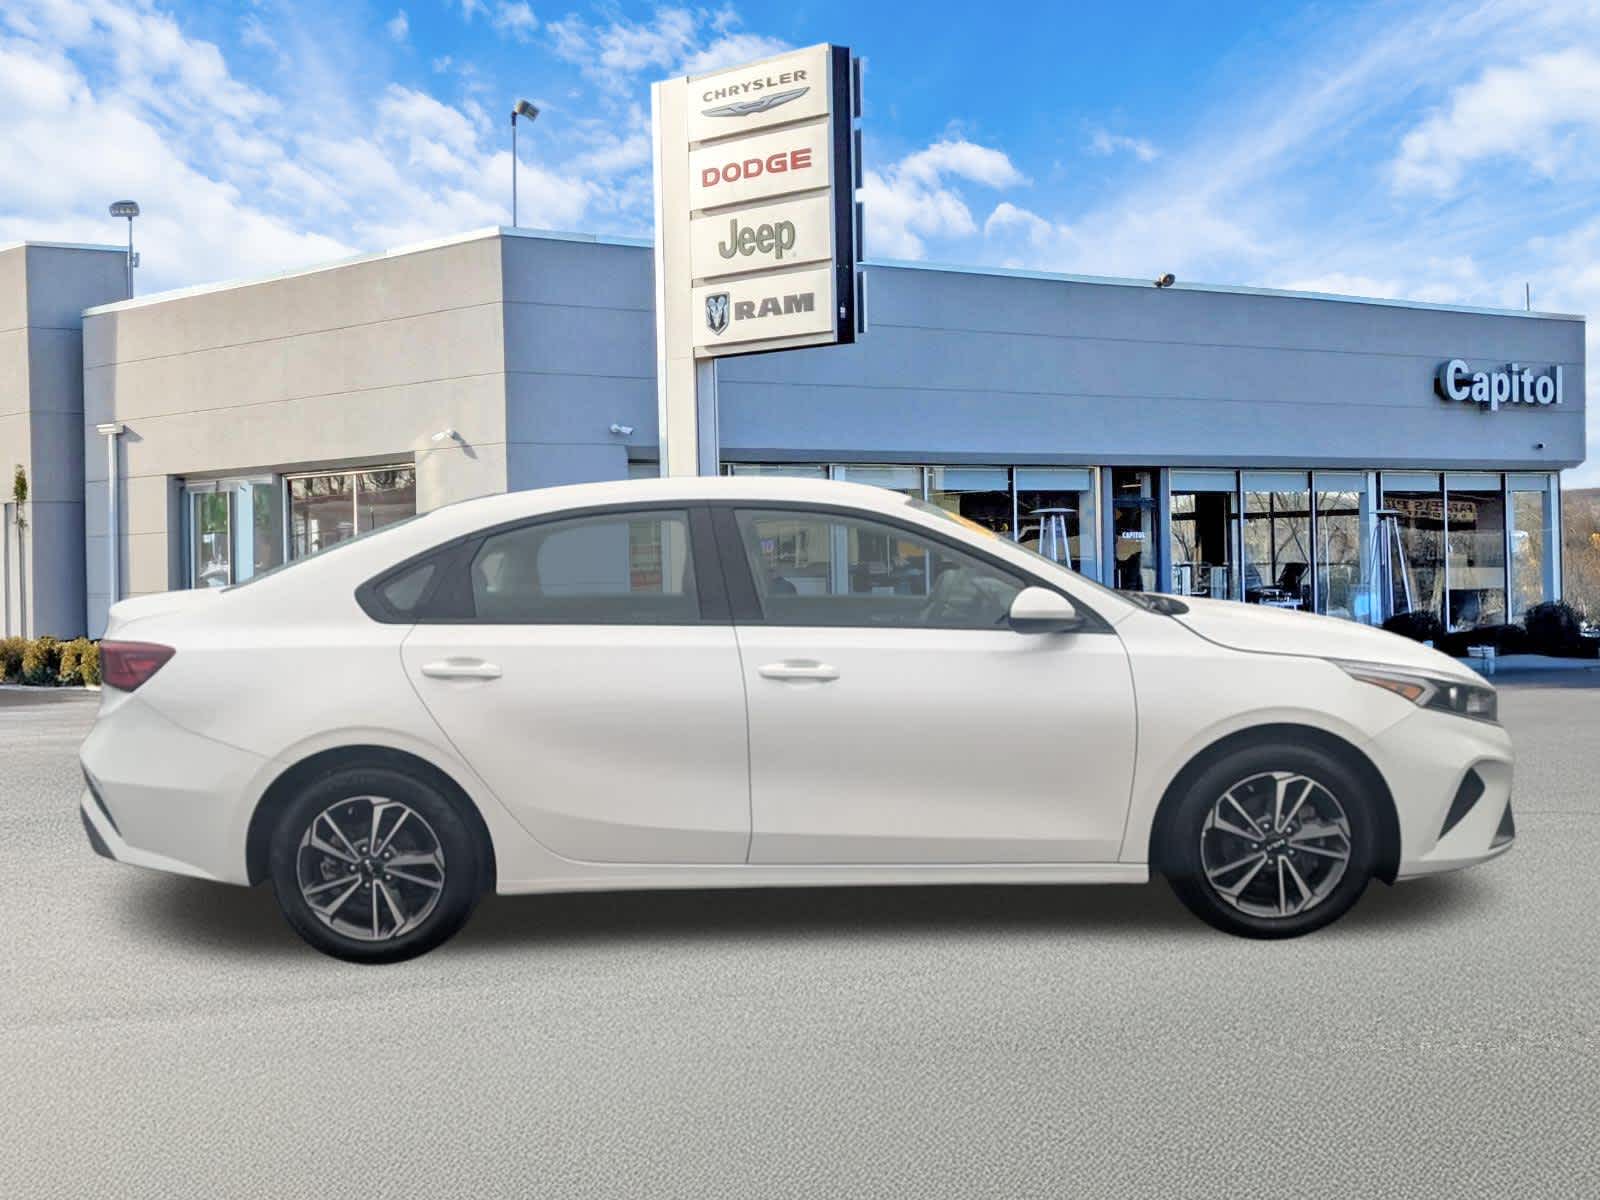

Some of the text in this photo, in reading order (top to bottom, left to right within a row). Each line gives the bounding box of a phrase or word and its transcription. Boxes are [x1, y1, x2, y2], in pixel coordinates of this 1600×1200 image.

[702, 69, 808, 103] CHRYSLER
[702, 148, 813, 188] DODGE
[718, 218, 796, 260] Jeep
[734, 292, 815, 321] RAM
[1446, 359, 1563, 411] Capitol
